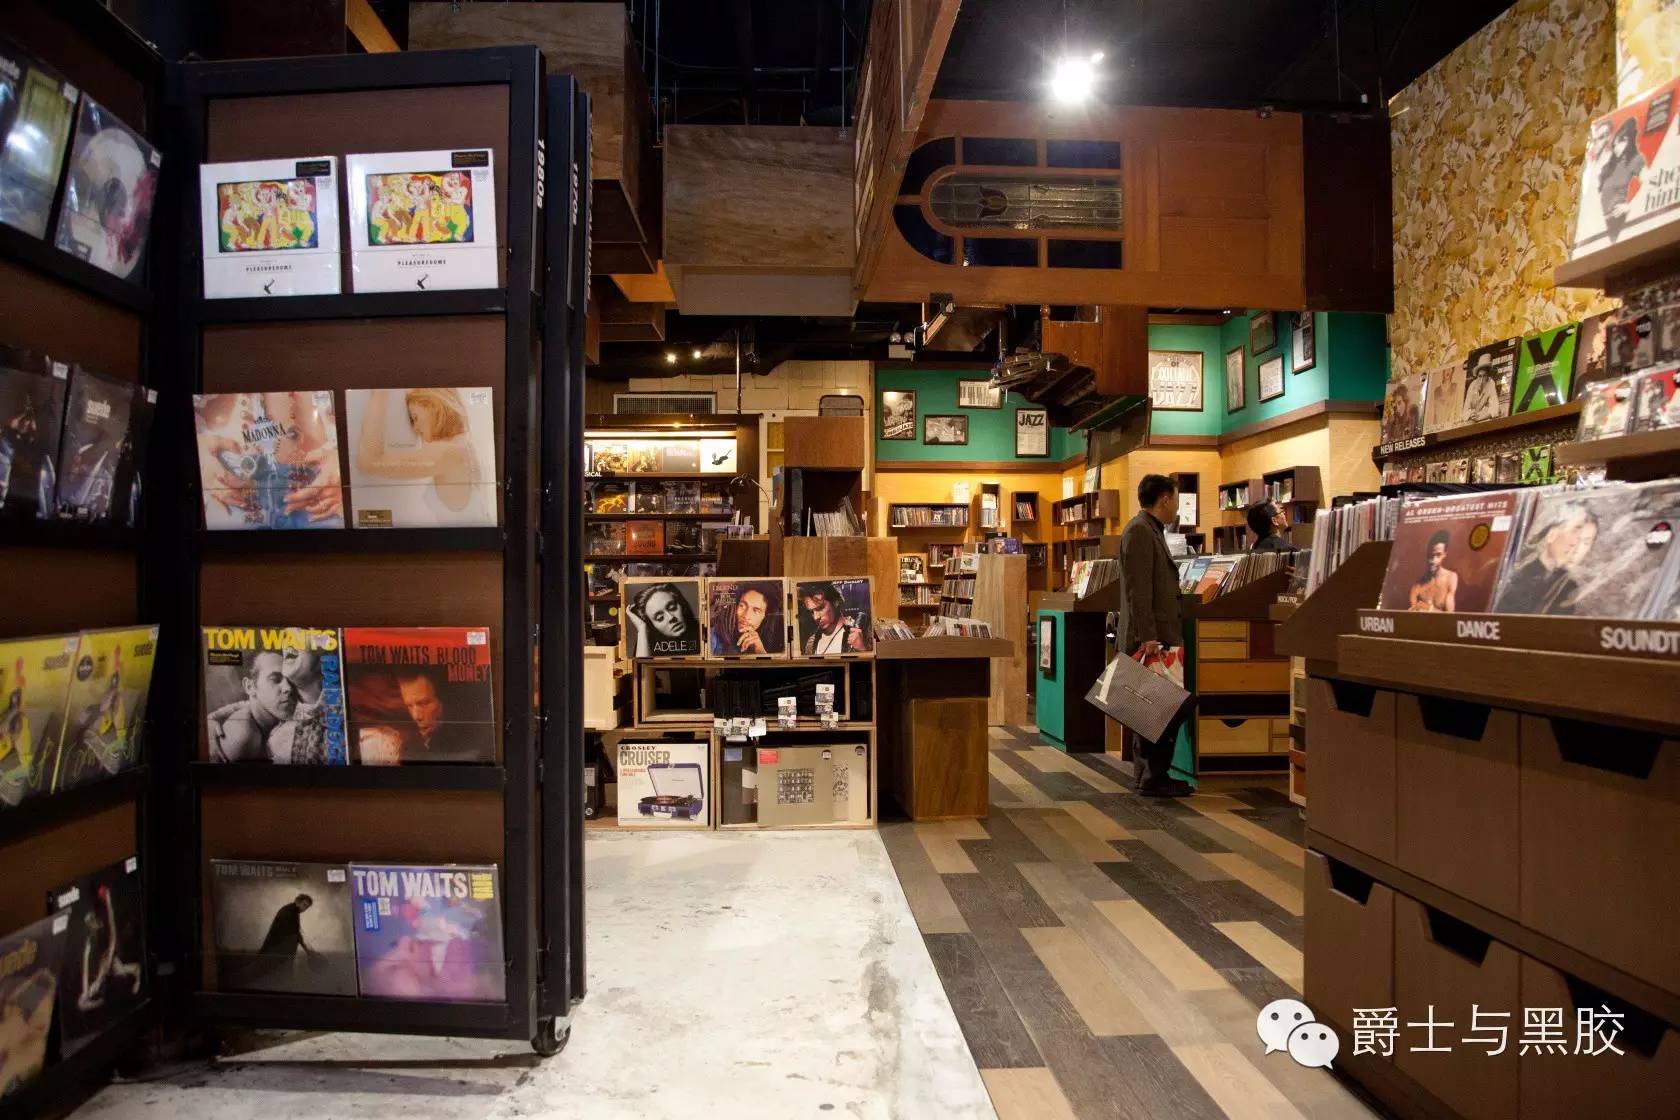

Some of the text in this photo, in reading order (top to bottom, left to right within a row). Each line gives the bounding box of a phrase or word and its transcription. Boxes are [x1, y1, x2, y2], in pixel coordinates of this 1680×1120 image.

[537, 139, 545, 209] 1980s
[1019, 413, 1045, 427] JAZZ
[241, 423, 288, 443] MADONNA
[1380, 436, 1426, 455] NEW RELEASES
[1360, 616, 1395, 633] URBAN
[1456, 620, 1501, 641] DANCE
[203, 627, 338, 652] TOM WAITS
[653, 640, 688, 652] ADELE
[360, 645, 477, 665] TOM WAITS BLOOD
[447, 664, 490, 682] MONEY
[620, 751, 671, 767] CRUISER
[353, 870, 399, 897] TOM
[400, 871, 468, 899] WAITS
